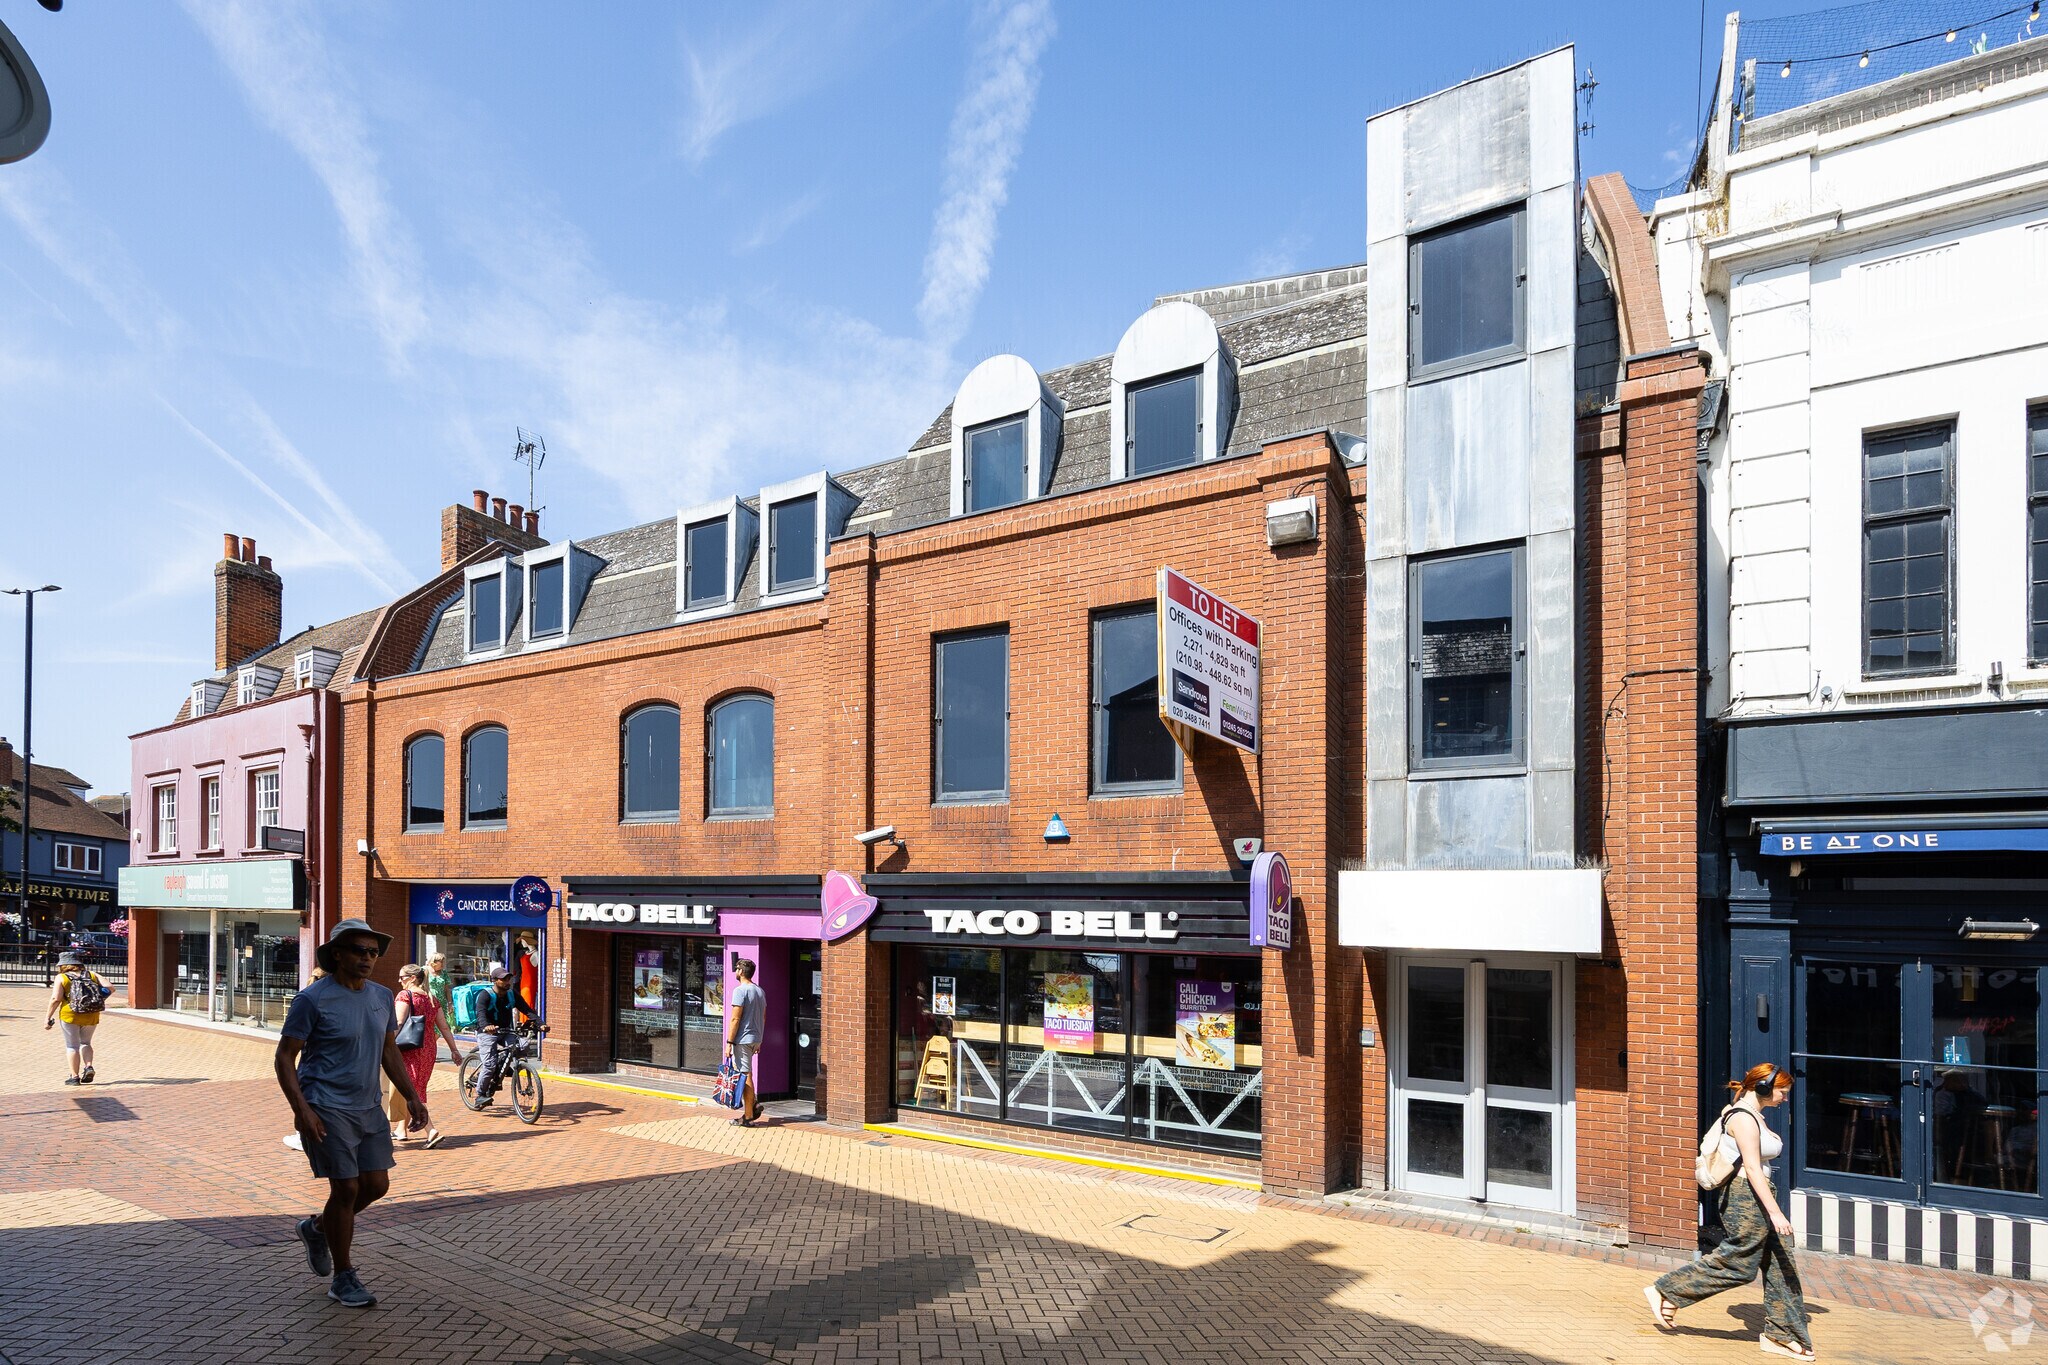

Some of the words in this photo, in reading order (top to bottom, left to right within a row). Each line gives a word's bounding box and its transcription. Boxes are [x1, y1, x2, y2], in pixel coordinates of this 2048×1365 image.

[1189, 585, 1210, 616] TO
[1213, 602, 1240, 634] LET
[1169, 606, 1203, 636] Offices
[1204, 628, 1224, 649] with
[1225, 639, 1257, 669] Parking
[1183, 635, 1203, 656] 2,271
[1209, 650, 1229, 669] 4,829
[1230, 662, 1239, 676] sq
[1240, 665, 1246, 678] ft
[1175, 649, 1203, 673] (210.98
[1208, 668, 1232, 688] 448.62
[1233, 682, 1242, 695] sq
[1243, 686, 1253, 700] m)
[1177, 681, 1208, 704] Sandrove
[1172, 705, 1184, 718] 020
[1198, 717, 1211, 730] 7411
[1782, 836, 1813, 851] BE
[1827, 835, 1861, 849] AT
[1872, 833, 1939, 848] ONE
[186, 868, 204, 890] sound
[210, 867, 229, 889] vision
[66, 887, 110, 903] TIME
[457, 899, 488, 911] CANCER
[490, 899, 516, 911] RESEA
[566, 902, 635, 923] TACO
[924, 909, 1041, 936] TACO
[1268, 914, 1290, 931] TACO
[1269, 929, 1290, 944] BELL
[1179, 983, 1198, 994] CALI
[1179, 993, 1216, 1006] CHICKEN
[1179, 1003, 1208, 1012] BURRITO
[1044, 1018, 1062, 1031] TACO
[1063, 1019, 1094, 1033] TUESDAY
[1102, 1066, 1121, 1075] TACOS
[1202, 1070, 1227, 1080] NACHOS
[1227, 1078, 1248, 1089] TACOS
